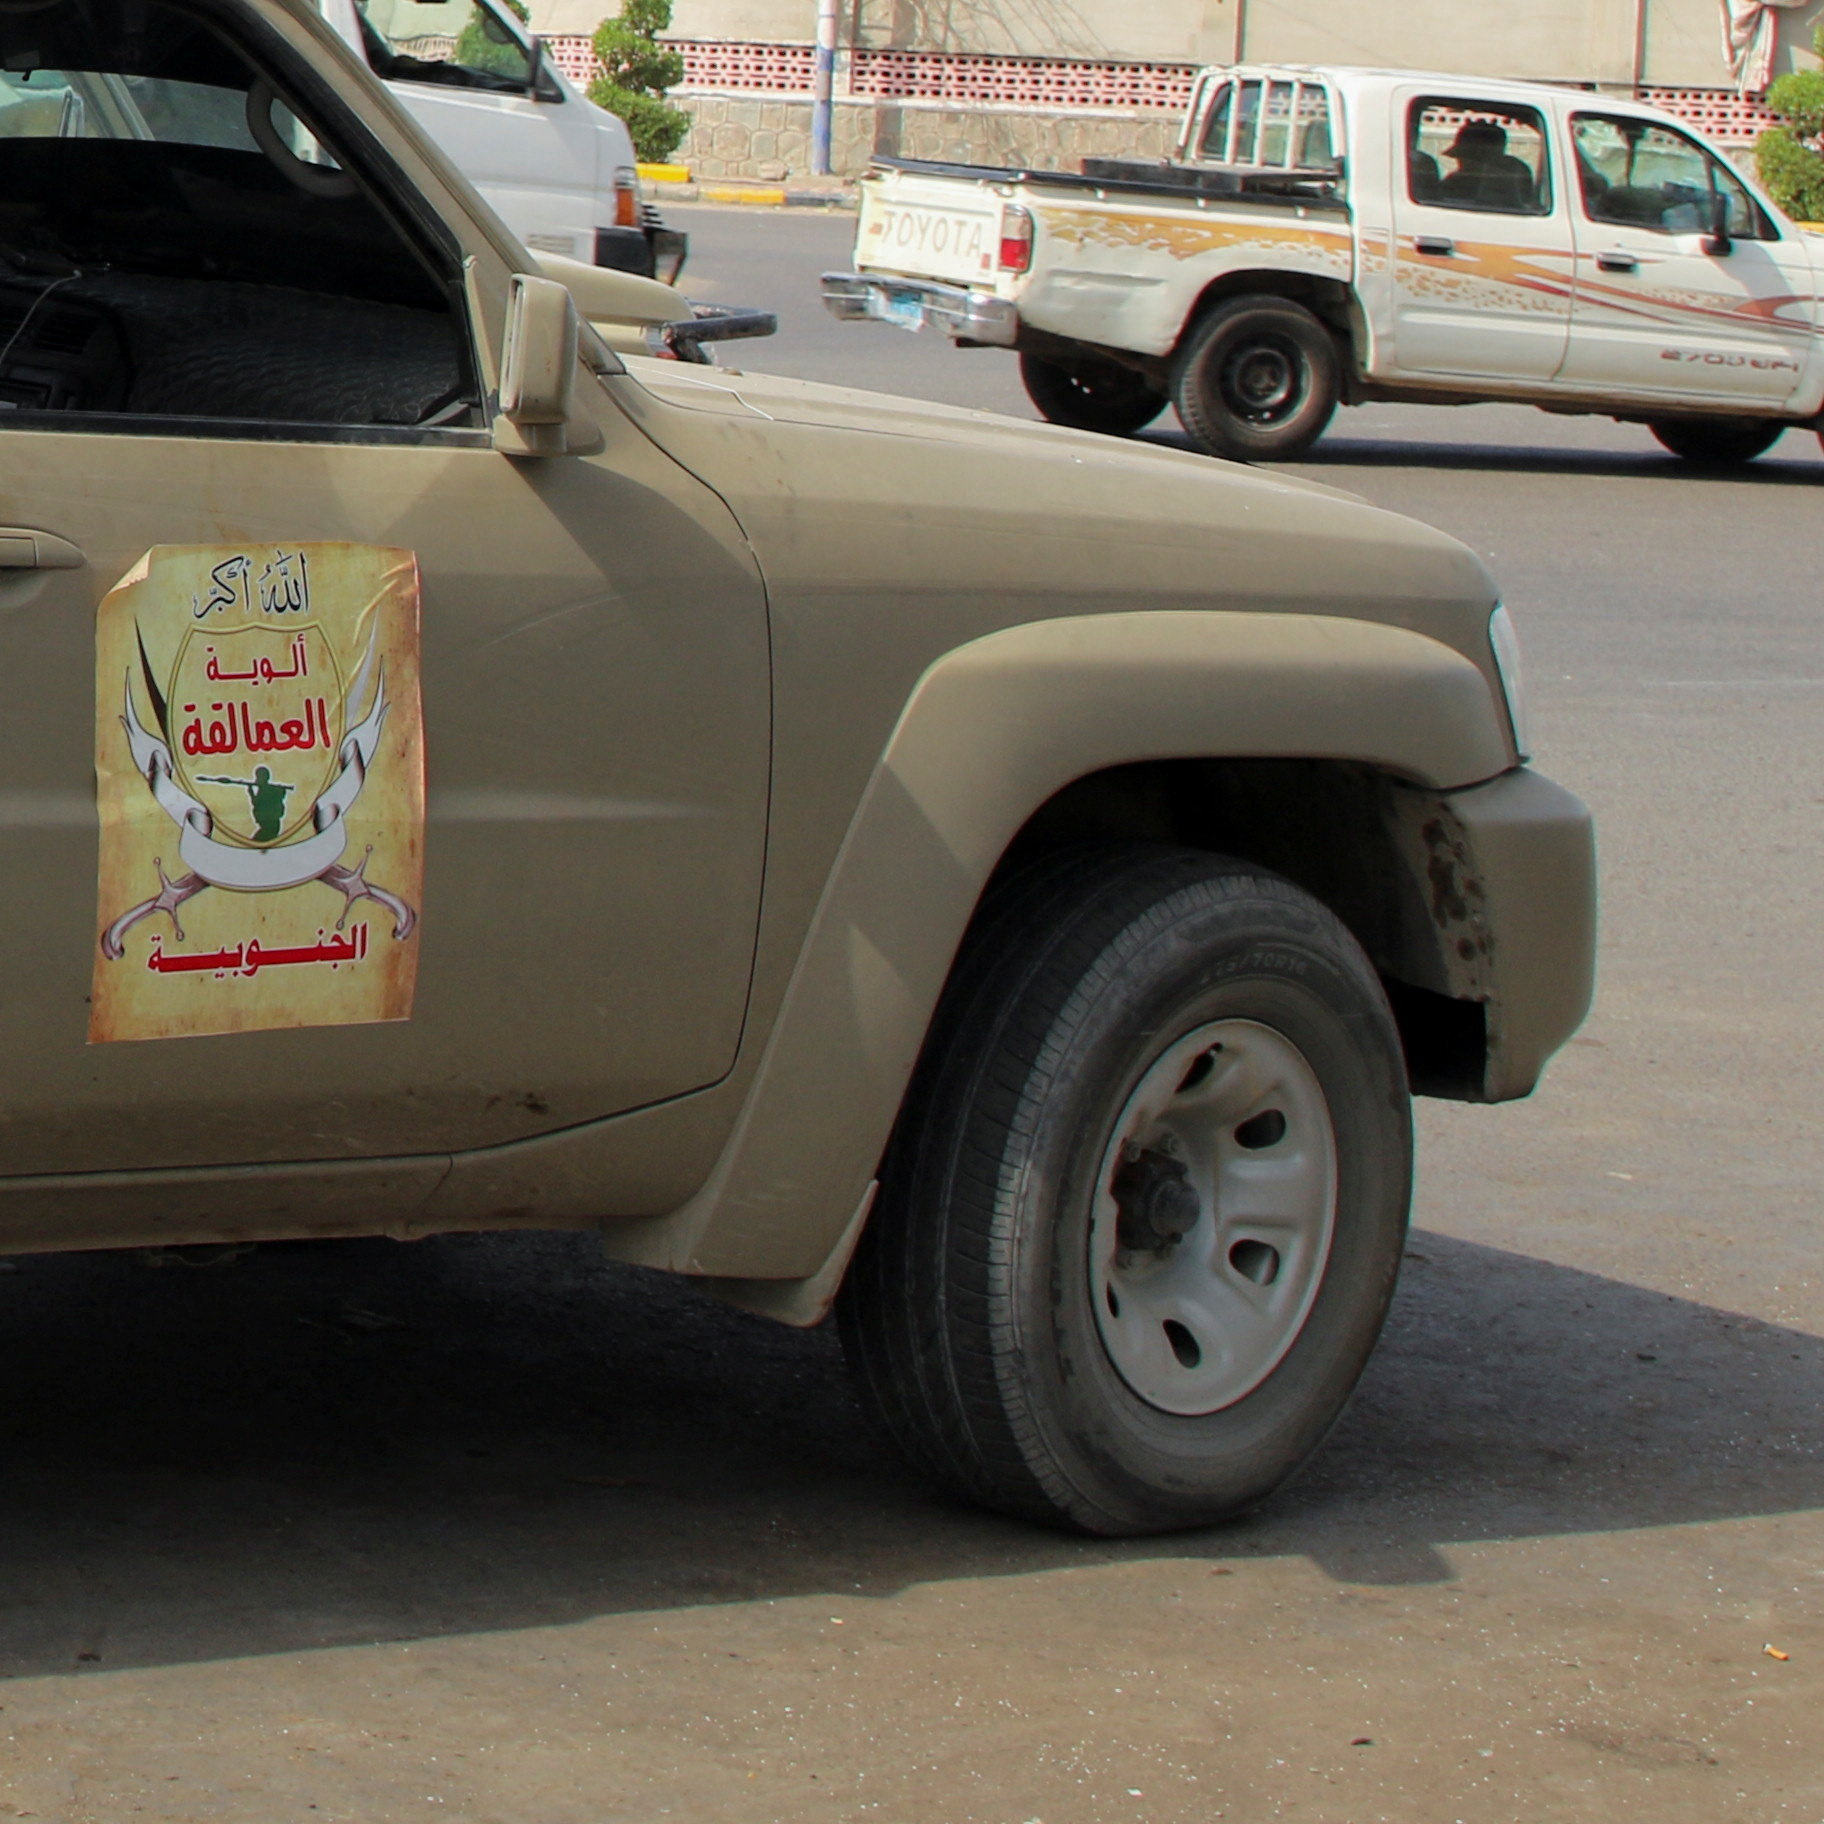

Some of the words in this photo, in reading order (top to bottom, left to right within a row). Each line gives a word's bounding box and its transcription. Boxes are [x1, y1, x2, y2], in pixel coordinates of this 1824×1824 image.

[881, 209, 984, 258] TOYOTA
[205, 633, 309, 684] ألوية
[182, 698, 331, 756] العمالقة
[146, 922, 367, 979] الجنوبية
